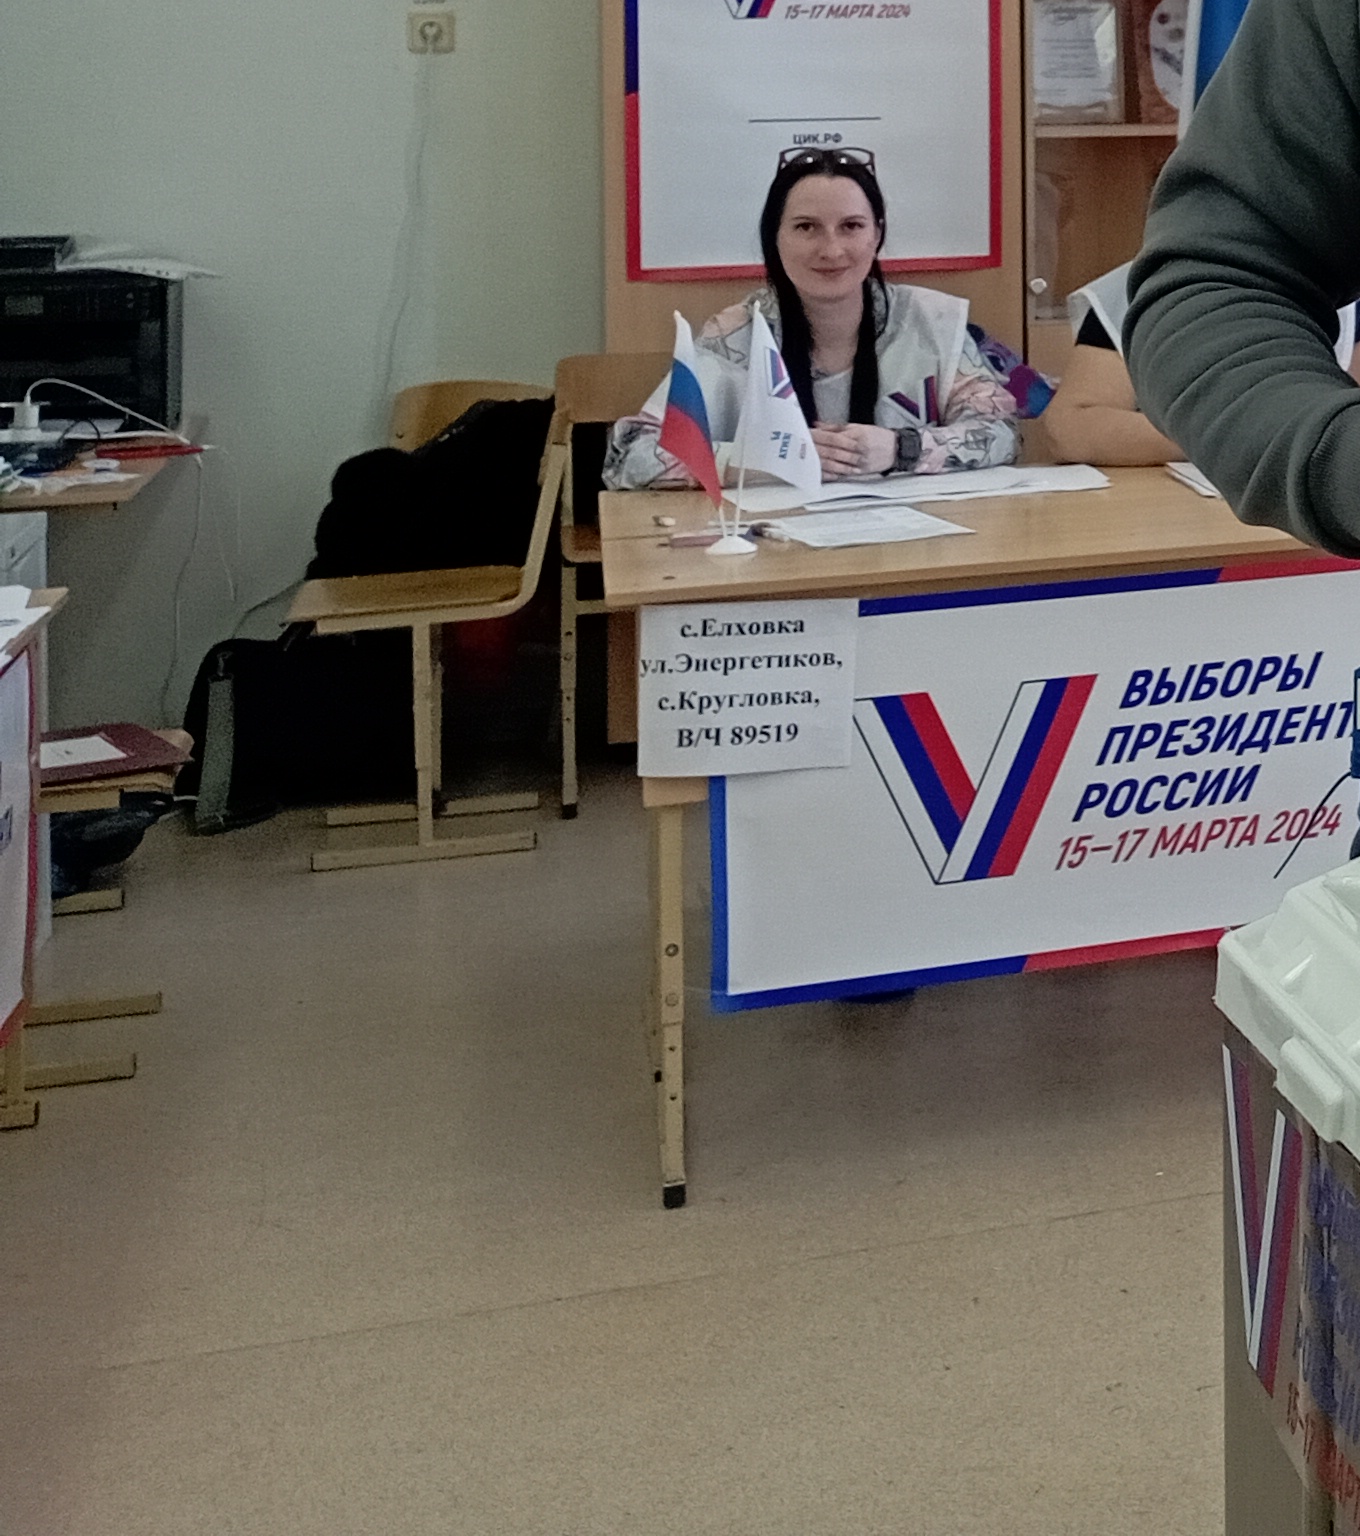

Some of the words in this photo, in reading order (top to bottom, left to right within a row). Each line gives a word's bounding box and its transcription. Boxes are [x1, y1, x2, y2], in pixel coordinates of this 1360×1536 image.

[827, 4, 873, 19] МАРТА
[876, 4, 911, 19] 2024
[793, 133, 843, 145] ЦИК.РФ
[680, 617, 805, 638] с.Елховка
[639, 651, 843, 678] ул.Энергетиков,
[1119, 651, 1324, 710] ВЫБОРЫ
[657, 688, 821, 715] с.Кругловка,
[676, 726, 721, 748] В/Ч
[730, 722, 799, 746] 89519
[1096, 700, 1354, 766] ПРЕЗИДЕНТ
[1072, 764, 1262, 823] РОССИИ
[1149, 814, 1261, 859] МАРТА
[1264, 804, 1342, 845] 2024
